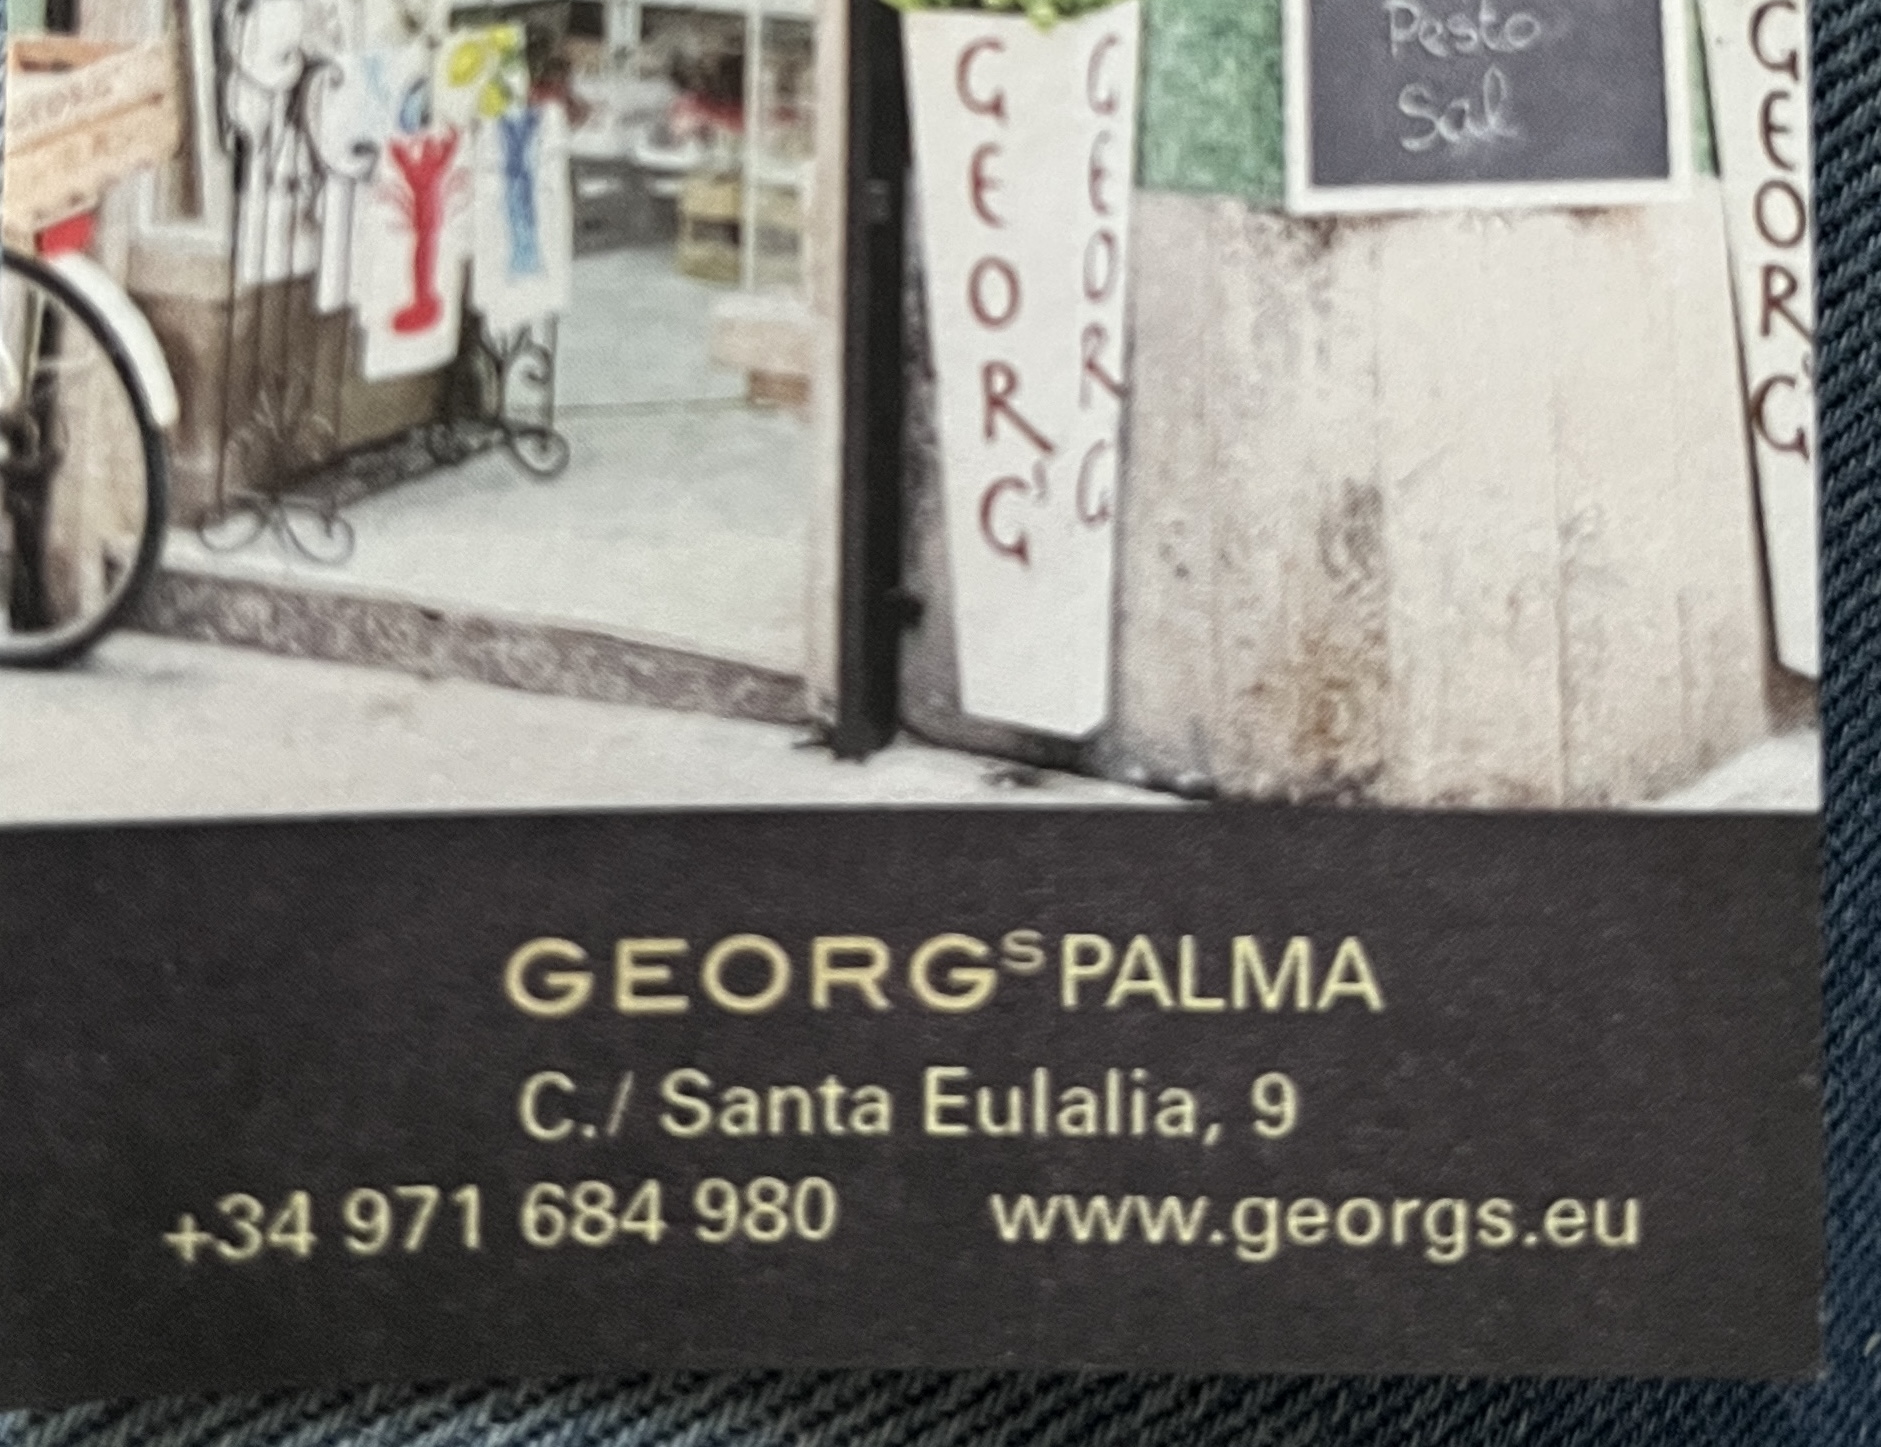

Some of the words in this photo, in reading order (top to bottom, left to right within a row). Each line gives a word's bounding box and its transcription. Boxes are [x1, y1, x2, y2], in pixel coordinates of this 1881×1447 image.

[1398, 63, 1518, 152] Sal
[658, 1067, 894, 1136] Santa
[922, 1065, 1224, 1145] Eulalia,
[1251, 1071, 1299, 1138] 9
[163, 1188, 317, 1263] +34
[342, 1184, 484, 1256] 971
[519, 1178, 667, 1248] 684
[692, 1176, 838, 1244] 980
[990, 1192, 1641, 1263] www.georgs.eu
